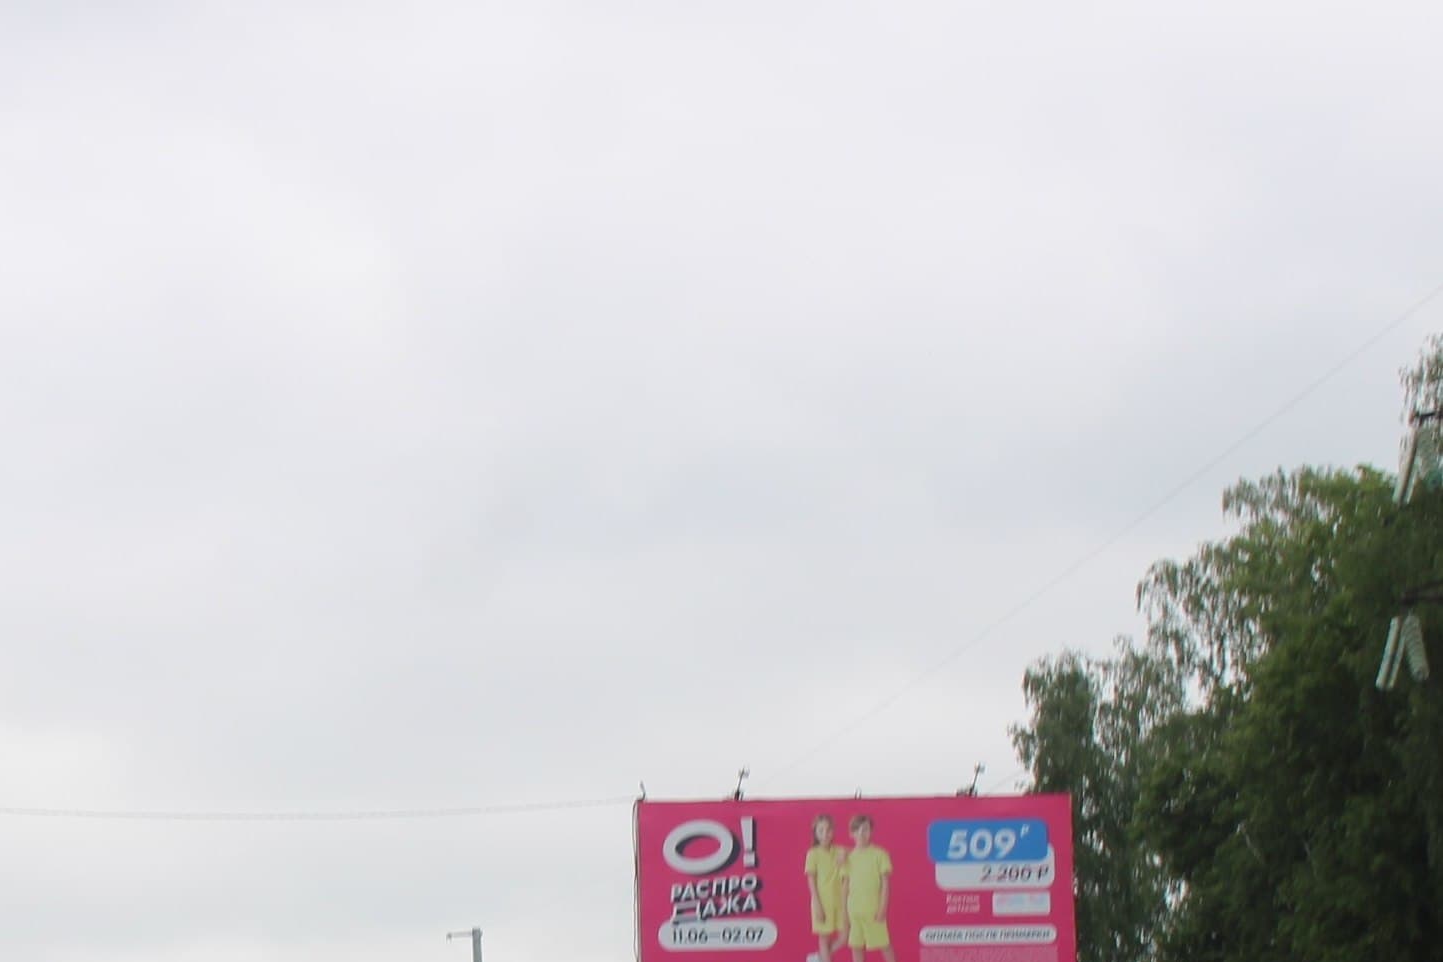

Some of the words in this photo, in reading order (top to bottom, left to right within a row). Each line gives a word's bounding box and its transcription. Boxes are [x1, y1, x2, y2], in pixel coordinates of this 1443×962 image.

[947, 828, 1016, 859] 509
[670, 874, 758, 903] РАСПРО
[670, 893, 758, 925] ДАЖА
